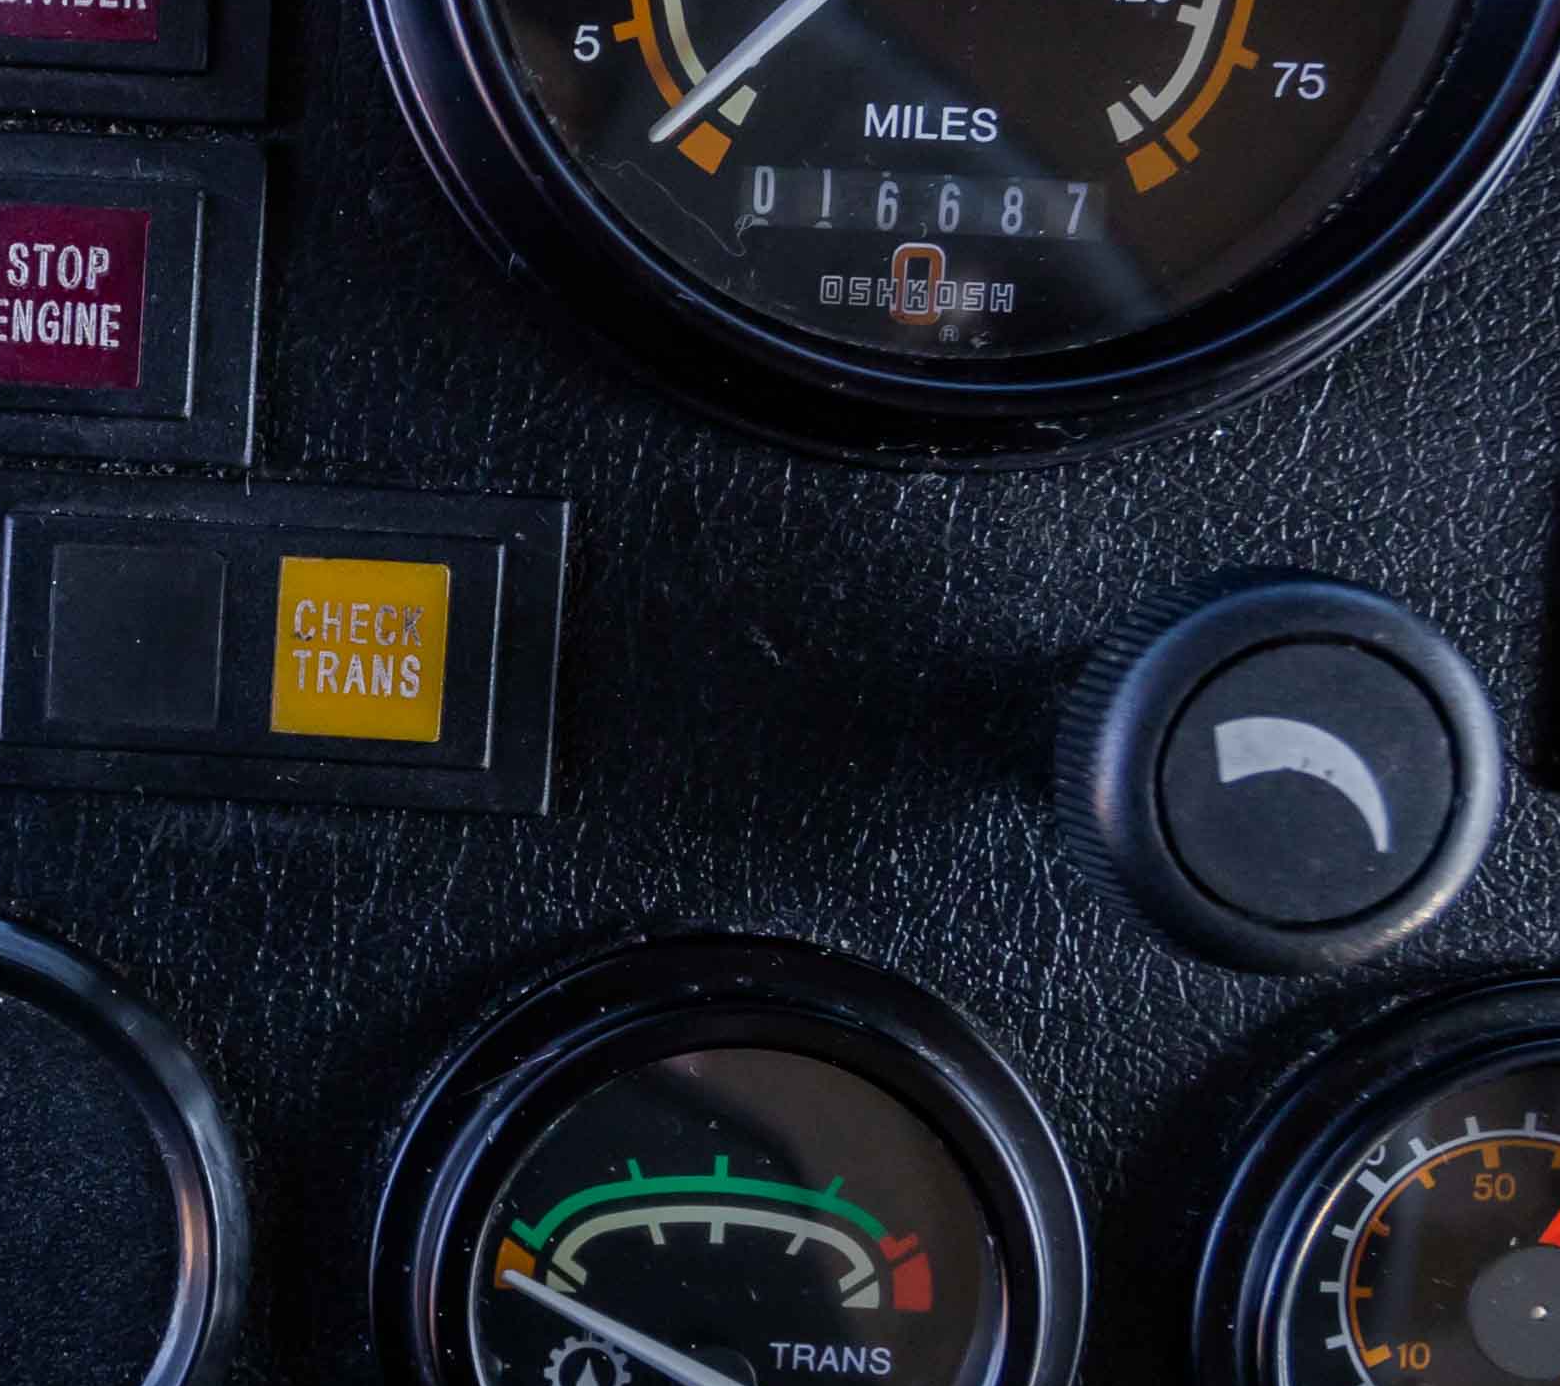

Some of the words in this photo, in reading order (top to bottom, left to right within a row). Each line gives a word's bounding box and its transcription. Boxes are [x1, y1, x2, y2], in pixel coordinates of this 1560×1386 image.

[572, 25, 601, 62] 5
[1271, 62, 1328, 101] 75
[863, 103, 1000, 144] MILES
[6, 241, 111, 290] STOP
[819, 273, 1016, 313] OSHKOSH
[293, 597, 426, 648] CHECK
[292, 648, 422, 699] TRANS
[1472, 1173, 1516, 1203] 50
[769, 1341, 893, 1376] TRANS
[1396, 1341, 1432, 1371] 10
